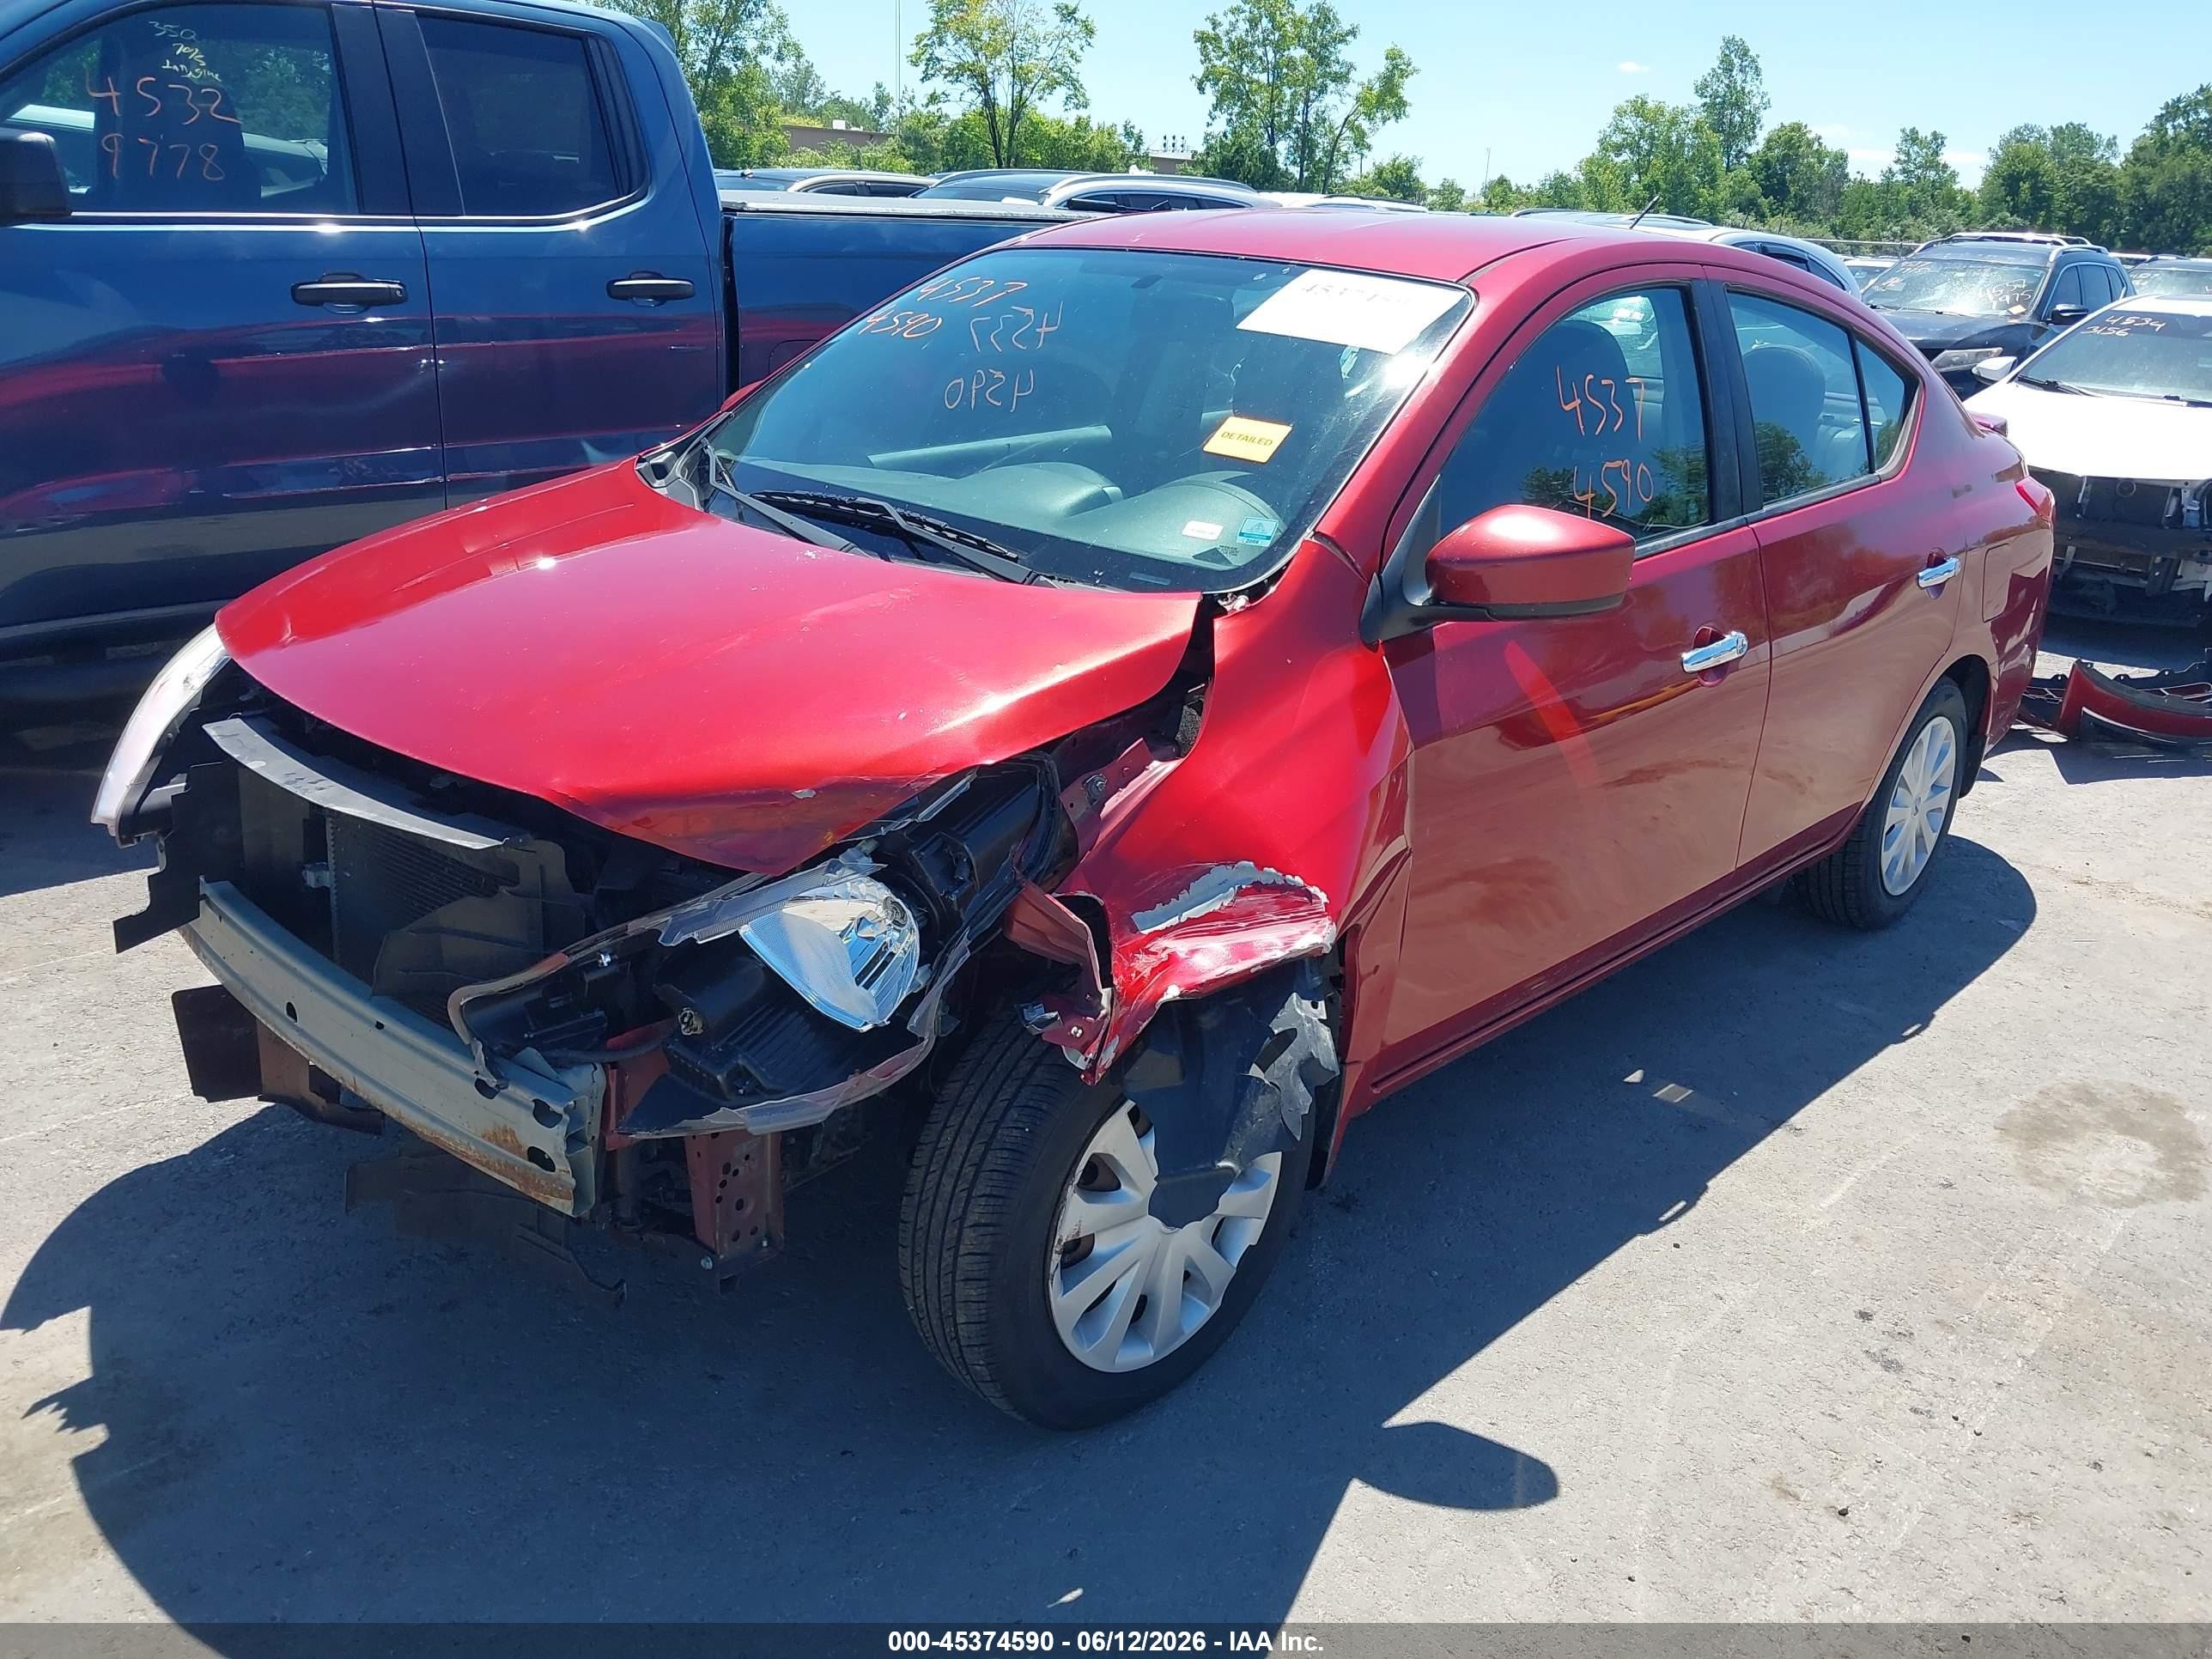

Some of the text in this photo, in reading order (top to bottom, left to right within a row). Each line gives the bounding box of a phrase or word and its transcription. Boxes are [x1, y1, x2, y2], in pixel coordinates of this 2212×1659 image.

[87, 74, 243, 125] 4532
[101, 134, 226, 181] 9778
[916, 276, 1029, 308] 4537
[858, 304, 943, 339] 4590
[2081, 325, 2132, 337] 3156
[2105, 315, 2166, 332] 4534
[1556, 364, 1645, 441] 4537
[1220, 431, 1273, 447] DETAILED
[1573, 459, 1654, 519] 4590
